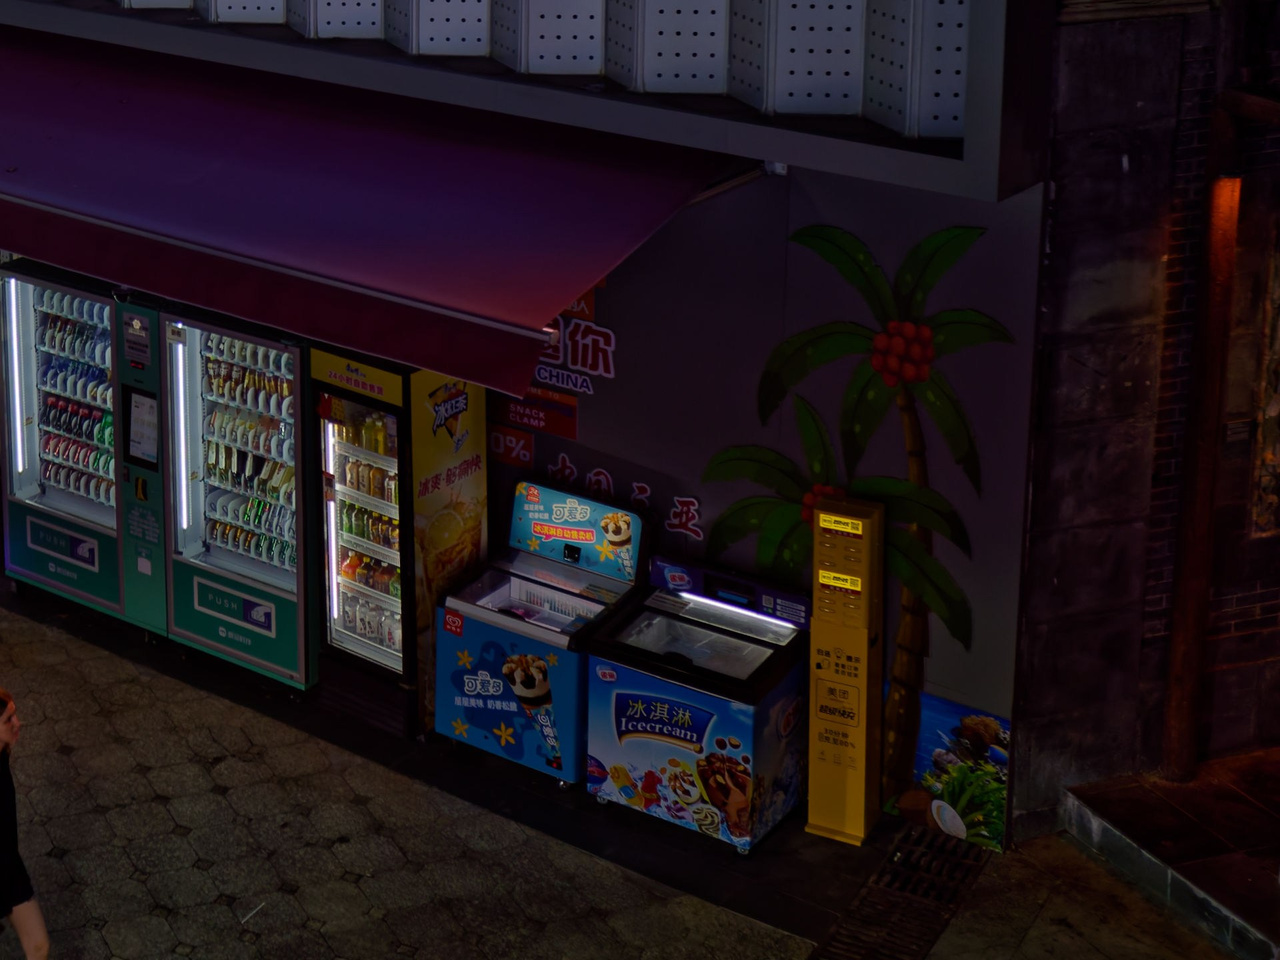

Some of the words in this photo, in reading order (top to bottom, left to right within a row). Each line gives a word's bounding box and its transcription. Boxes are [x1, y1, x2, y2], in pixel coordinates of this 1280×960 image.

[539, 315, 616, 378] 你
[536, 365, 593, 394] CHINA
[509, 404, 546, 420] SNACK
[509, 413, 546, 429] CLAMP
[552, 503, 590, 522] 可爱多
[208, 593, 238, 610] PUSH
[463, 673, 504, 695] 可爱多
[827, 687, 849, 700] 美团
[626, 699, 693, 728] 冰淇淋
[620, 717, 698, 742] Icecream
